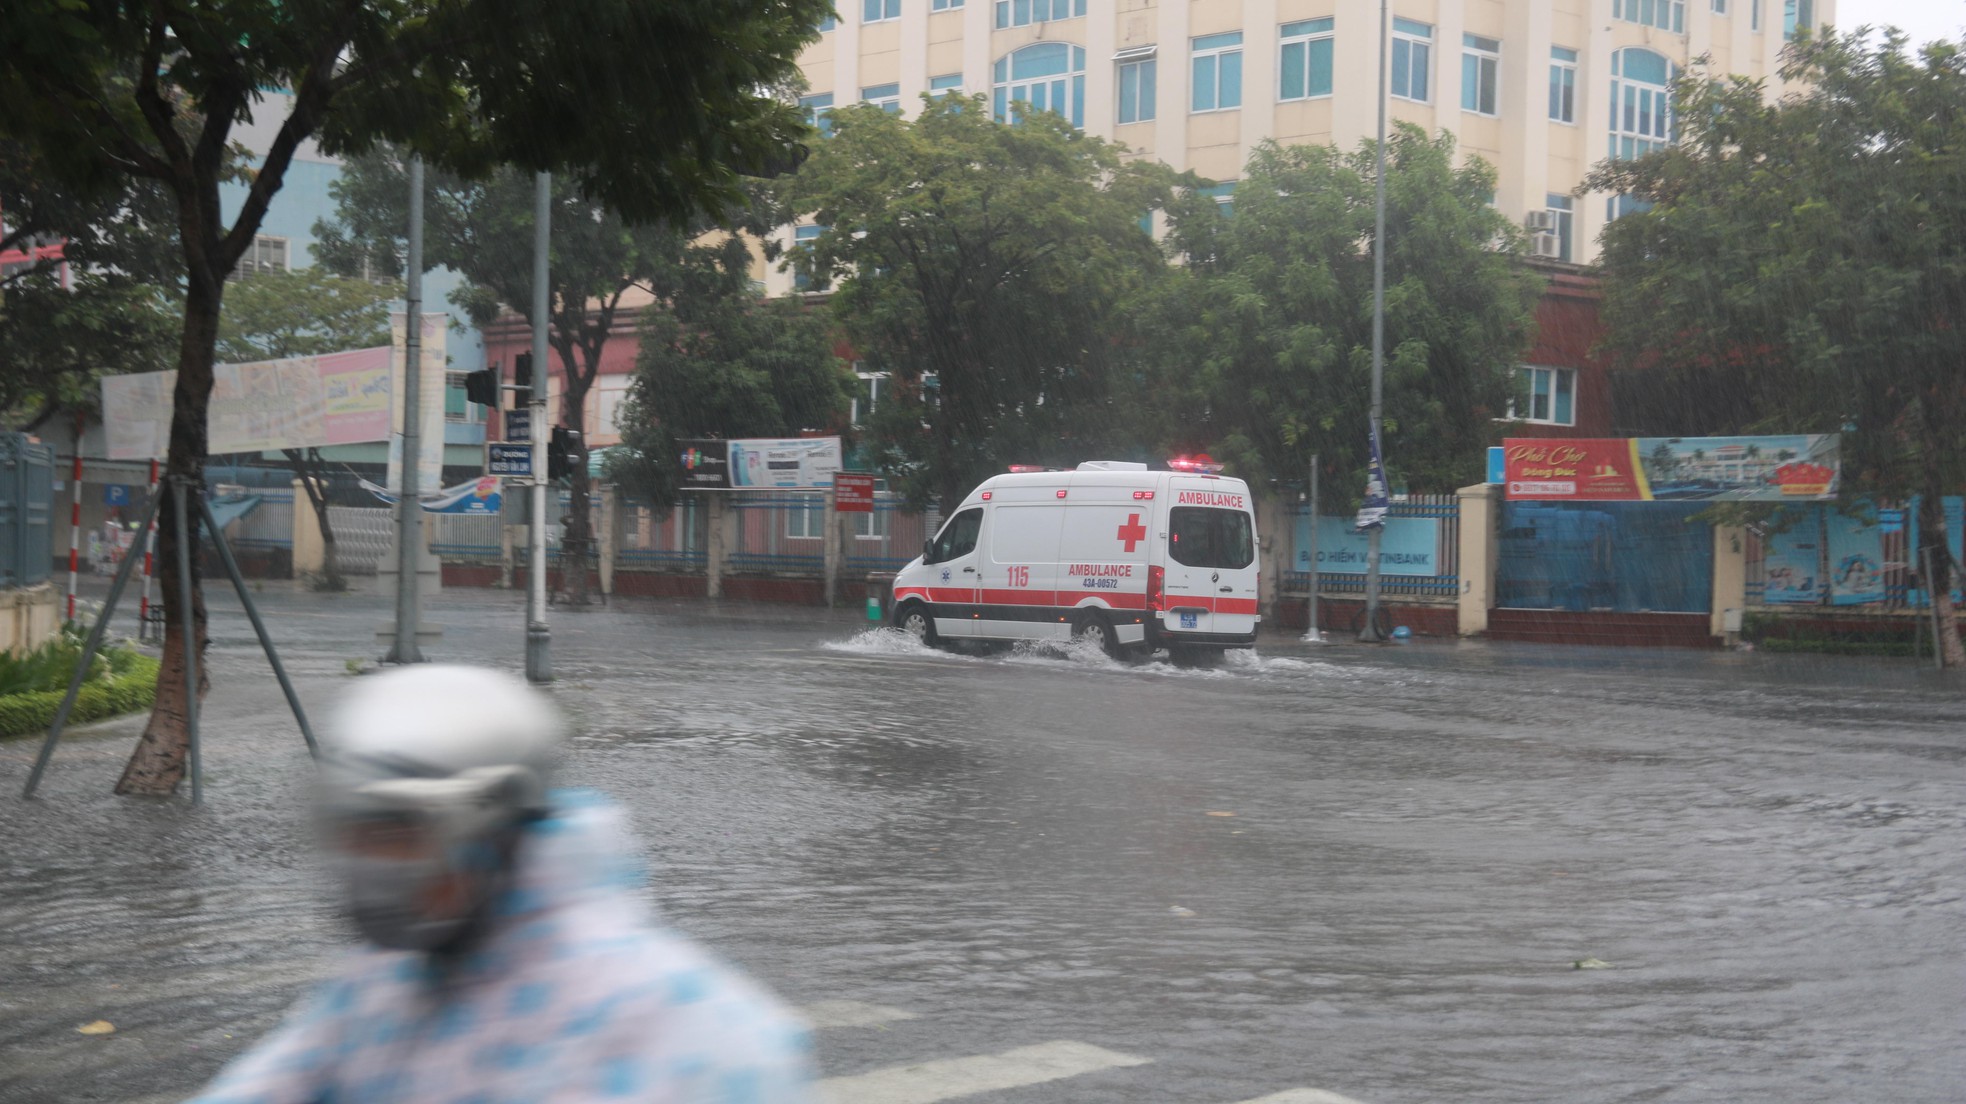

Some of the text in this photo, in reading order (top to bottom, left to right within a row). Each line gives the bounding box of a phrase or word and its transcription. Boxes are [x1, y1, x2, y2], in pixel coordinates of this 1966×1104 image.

[111, 487, 123, 500] P
[1178, 491, 1243, 508] AMBULANCE
[1301, 551, 1326, 562] BO
[1359, 551, 1430, 565] VTINBANK
[1007, 566, 1029, 587] 115
[1068, 564, 1132, 577] AMBULANCE
[1083, 578, 1117, 588] 43A-00572
